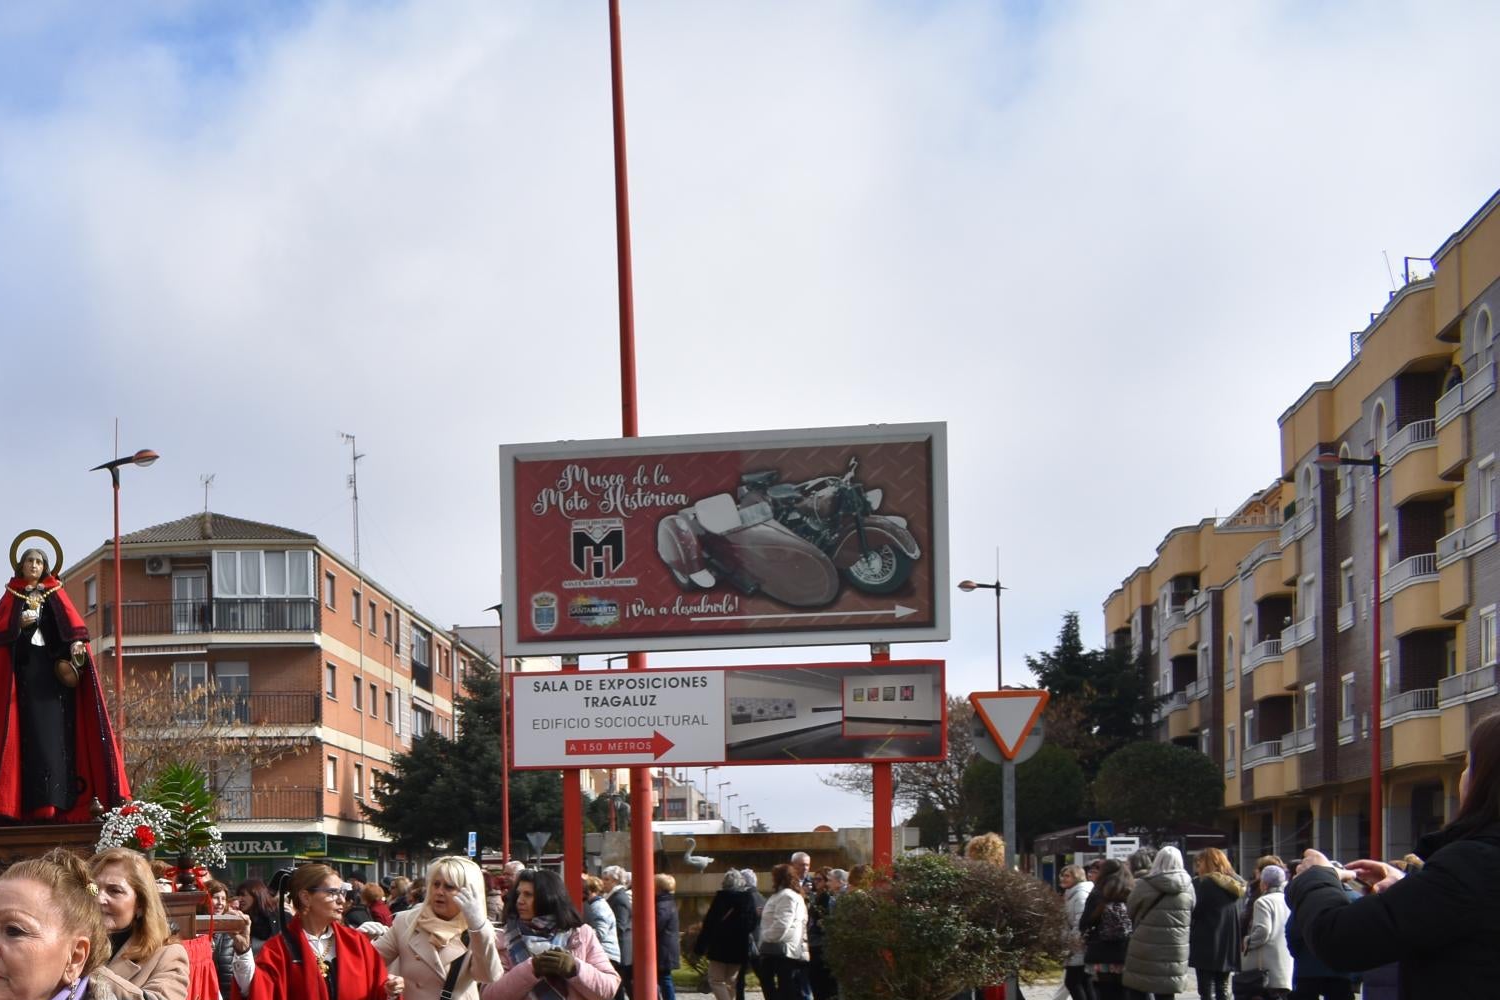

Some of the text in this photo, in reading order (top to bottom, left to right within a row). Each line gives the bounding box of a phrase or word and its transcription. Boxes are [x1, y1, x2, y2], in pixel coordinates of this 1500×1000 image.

[557, 464, 671, 495] Museo de la
[532, 484, 688, 519] Moto Histórica
[626, 597, 655, 618] ¡Ven
[660, 605, 668, 615] a
[533, 676, 708, 692] SALA DE EXPOSICIONES
[584, 695, 657, 708] TRAGALUZ
[532, 715, 709, 730] EDIFICIO SOCIOCULTURAL
[569, 741, 652, 752] A 150 METROS
[223, 840, 288, 853] RURAL
